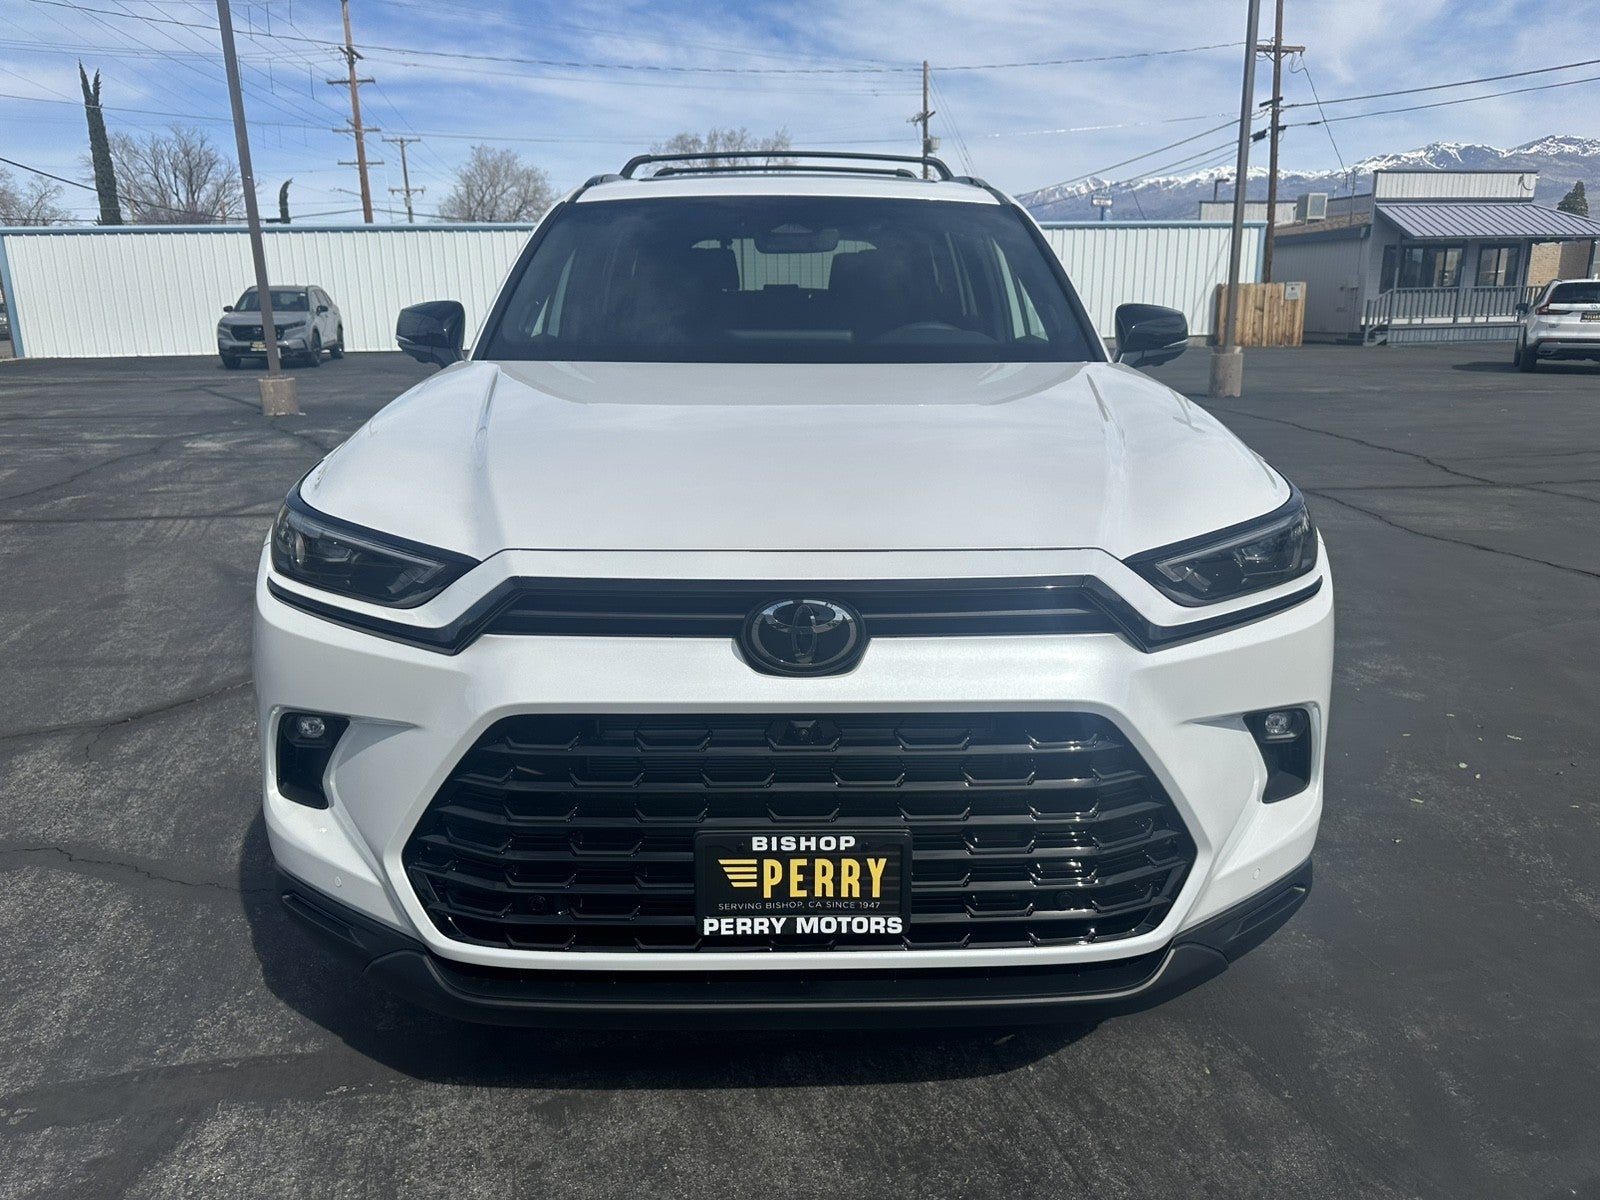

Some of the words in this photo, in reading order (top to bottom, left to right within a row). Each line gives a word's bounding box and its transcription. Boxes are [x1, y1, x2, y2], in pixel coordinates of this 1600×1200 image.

[752, 836, 856, 851] BISHOP
[763, 858, 887, 898] PERRY
[718, 902, 762, 910] SERVING
[826, 901, 855, 909] SINCE
[859, 901, 881, 909] 1947
[703, 917, 787, 935] PERRY
[796, 916, 903, 934] MOTORS
